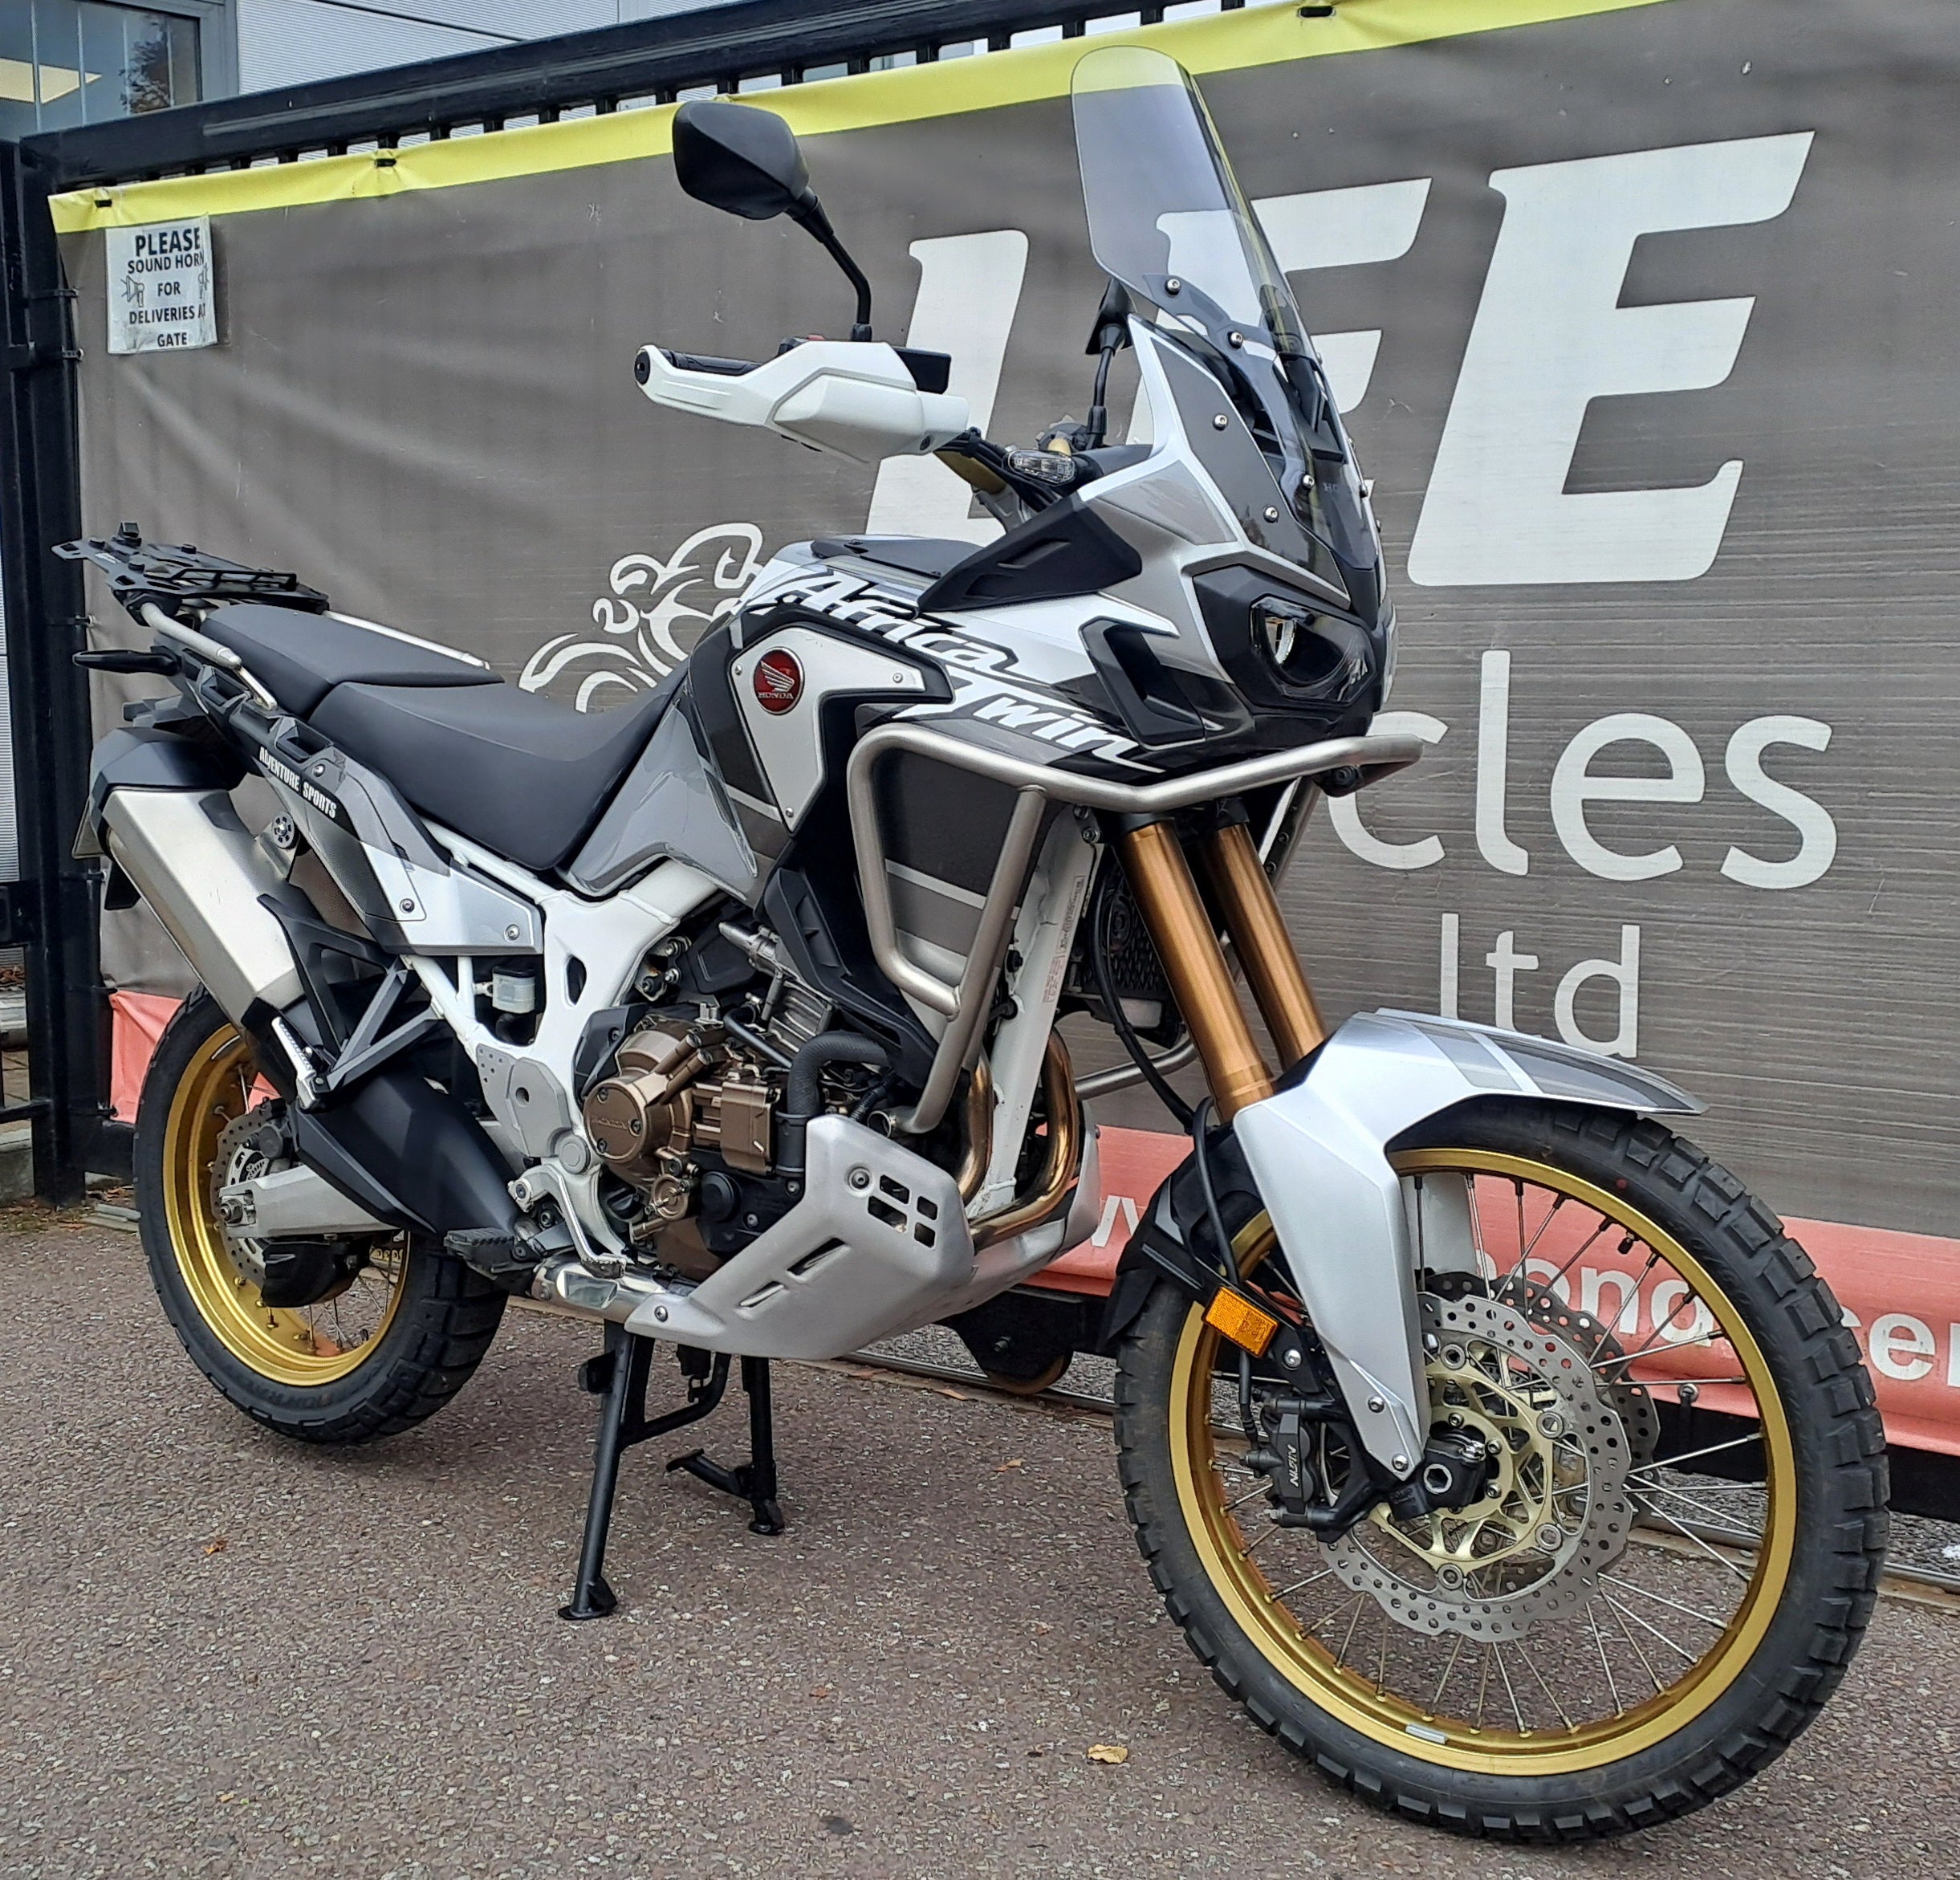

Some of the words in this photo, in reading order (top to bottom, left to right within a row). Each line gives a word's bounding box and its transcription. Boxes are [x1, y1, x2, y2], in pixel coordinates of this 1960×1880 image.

[135, 227, 201, 257] PLEASE
[128, 256, 171, 275] SOUND
[175, 250, 204, 269] HORN
[157, 281, 181, 297] FOR
[129, 305, 195, 325] DELIVERIES
[157, 332, 188, 348] GATE
[750, 566, 1013, 677] Africa
[758, 691, 795, 700] HONDA
[892, 665, 1166, 773] Twin
[258, 746, 300, 791] ADVENTURE
[303, 781, 337, 819] SPORTS
[1441, 913, 1641, 1059] ltd
